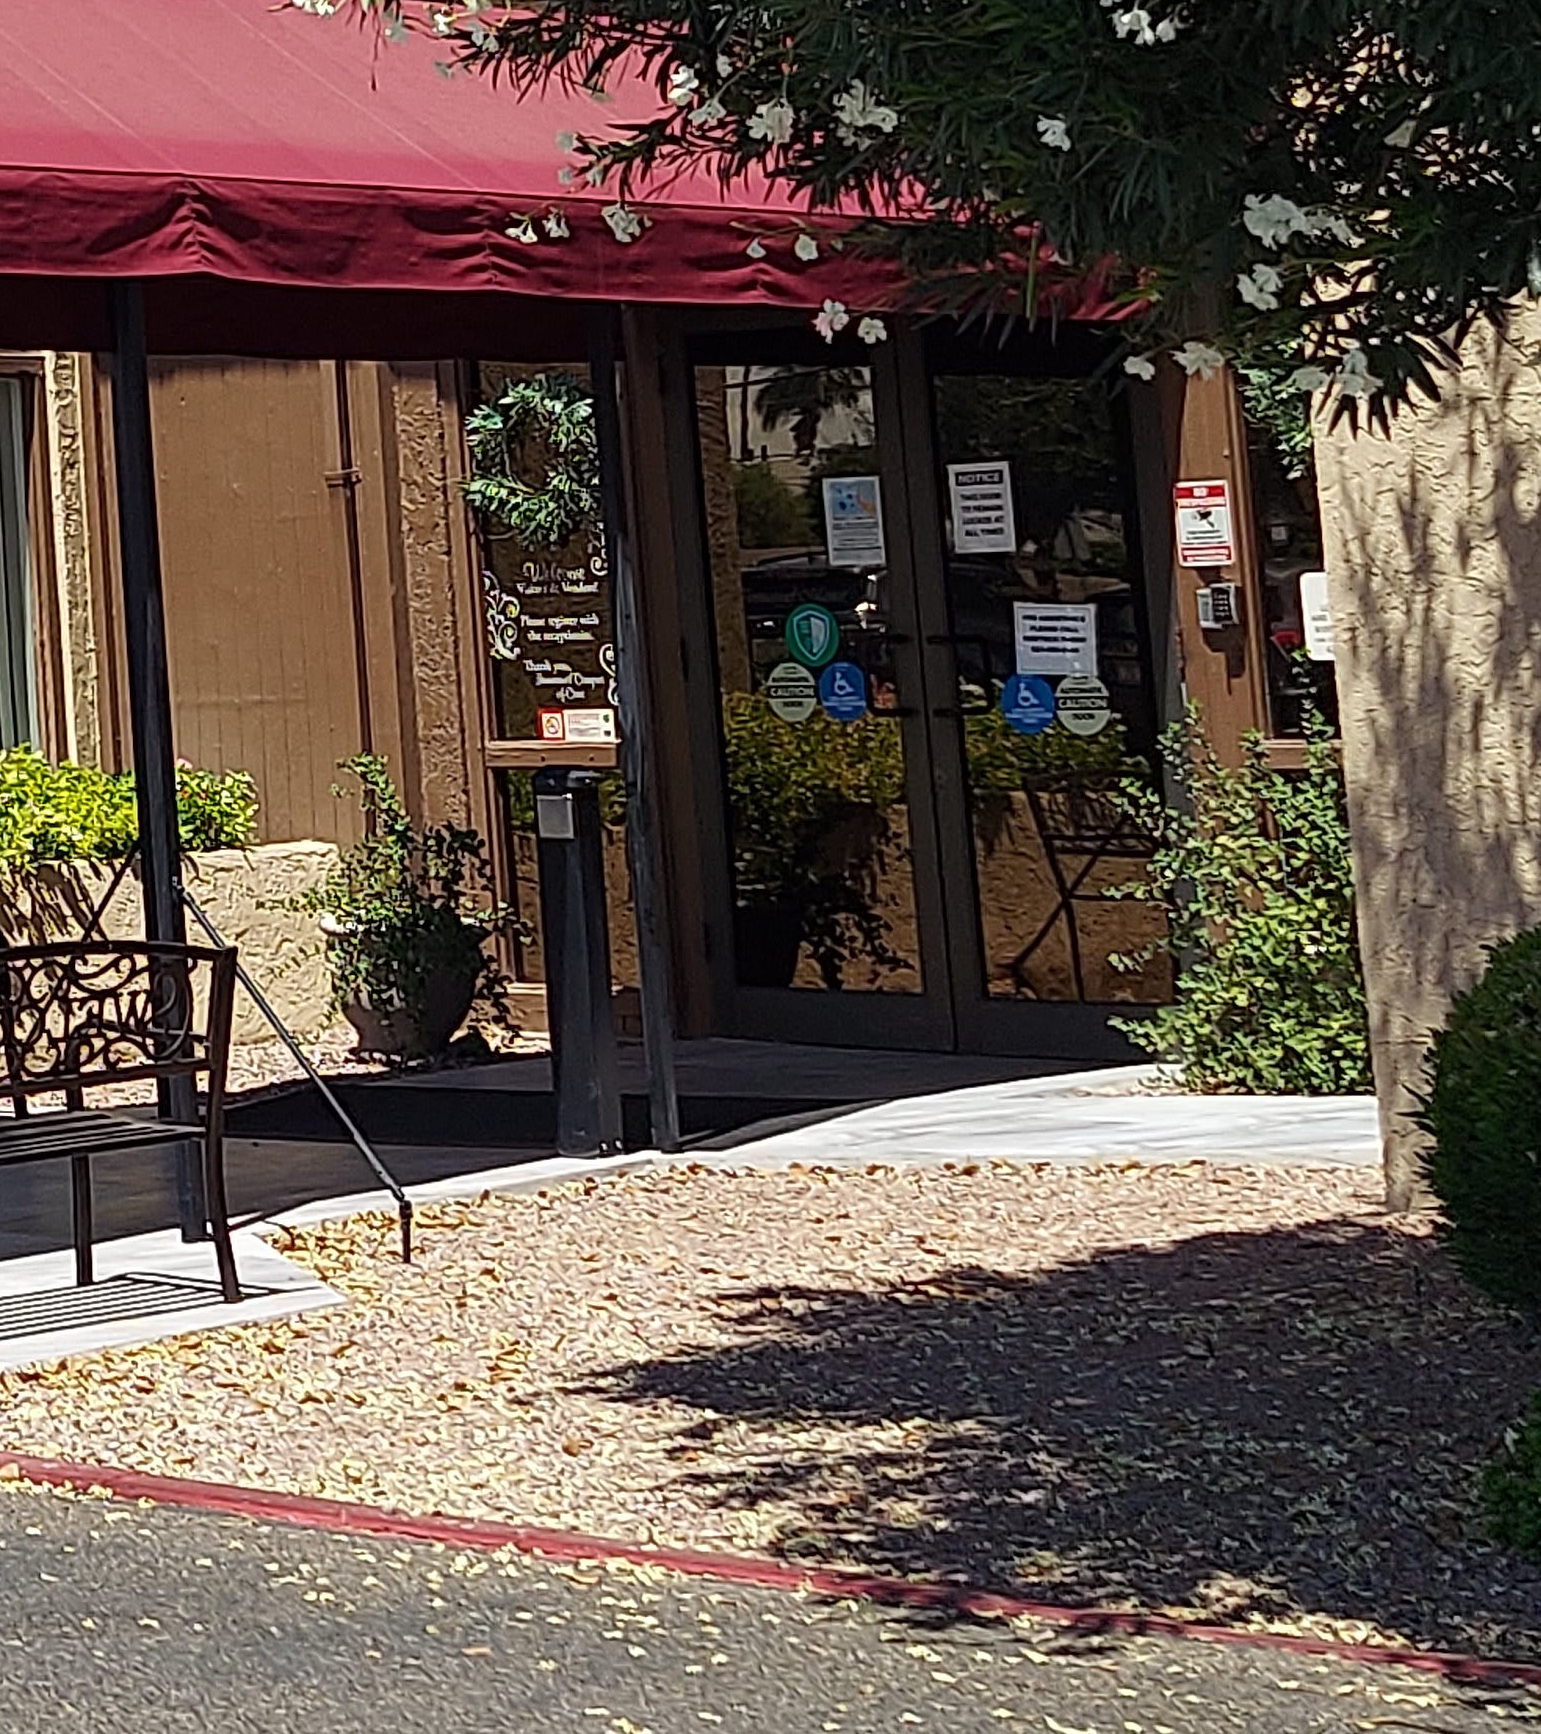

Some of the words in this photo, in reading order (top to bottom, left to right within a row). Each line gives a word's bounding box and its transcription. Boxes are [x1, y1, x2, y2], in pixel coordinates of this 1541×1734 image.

[957, 472, 1000, 484] NOTICE
[769, 687, 815, 697] CAUTION
[1057, 698, 1108, 708] CAUTION
